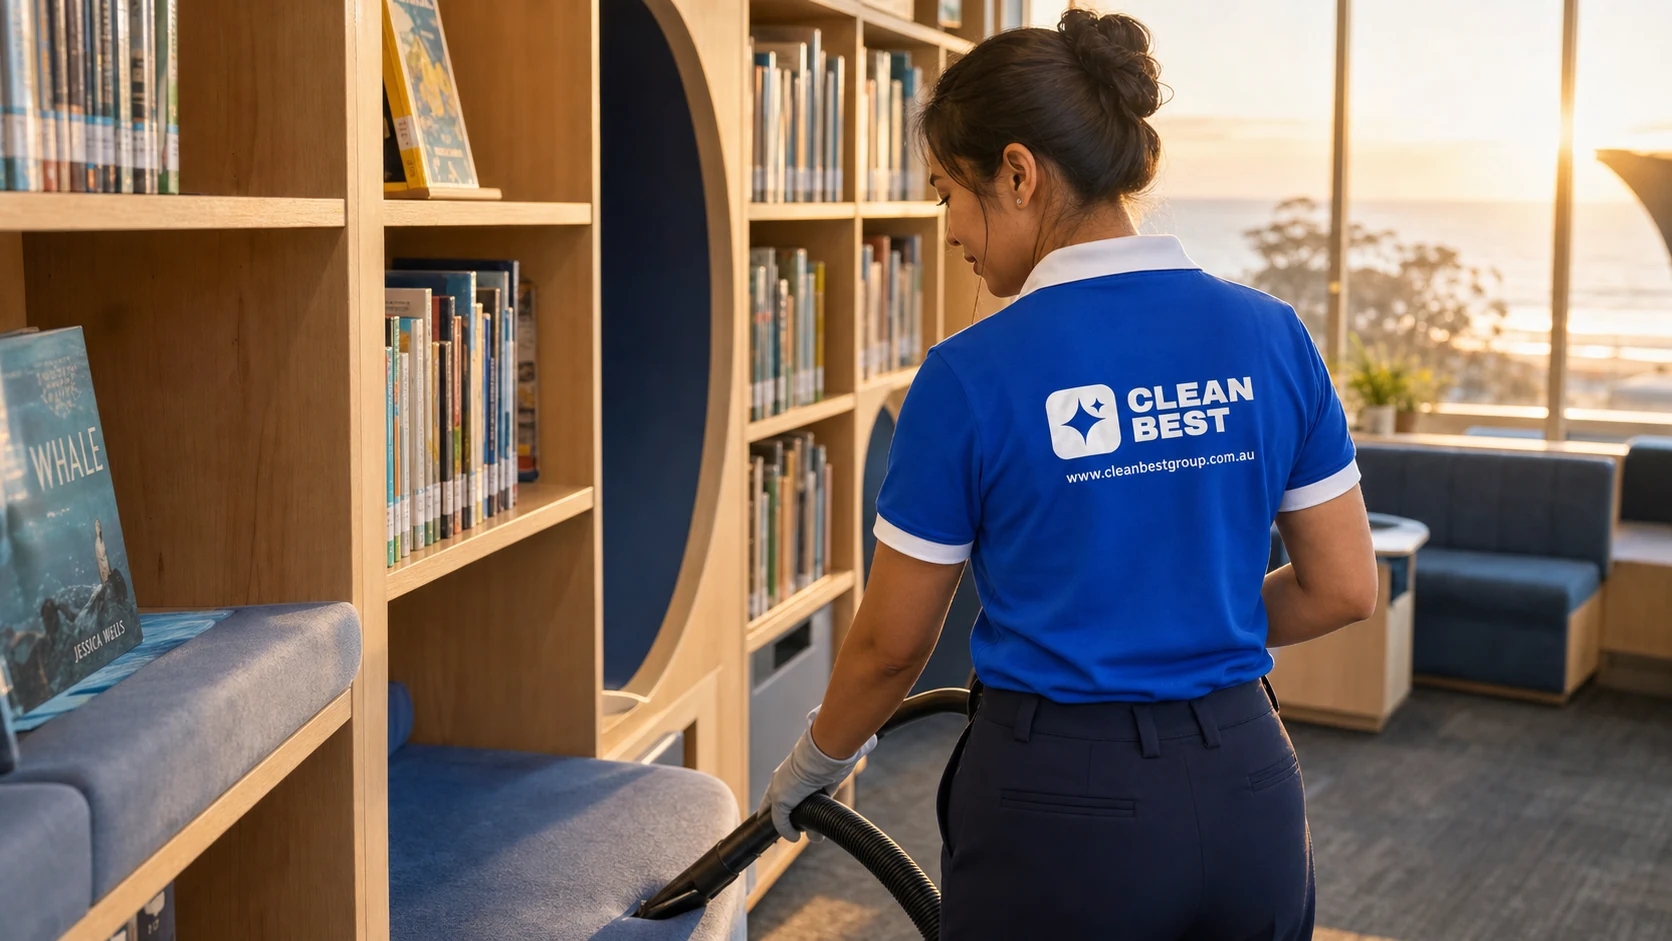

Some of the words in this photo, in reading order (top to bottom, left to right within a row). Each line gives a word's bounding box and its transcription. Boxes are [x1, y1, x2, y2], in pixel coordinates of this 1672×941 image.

[1127, 376, 1254, 413] CLEAN
[1132, 407, 1230, 443] BEST
[29, 426, 103, 492] WHALE
[1066, 451, 1255, 483] www.cleanbestgroup.com.au
[73, 633, 103, 663] JESSICA
[102, 620, 126, 643] WELLS
